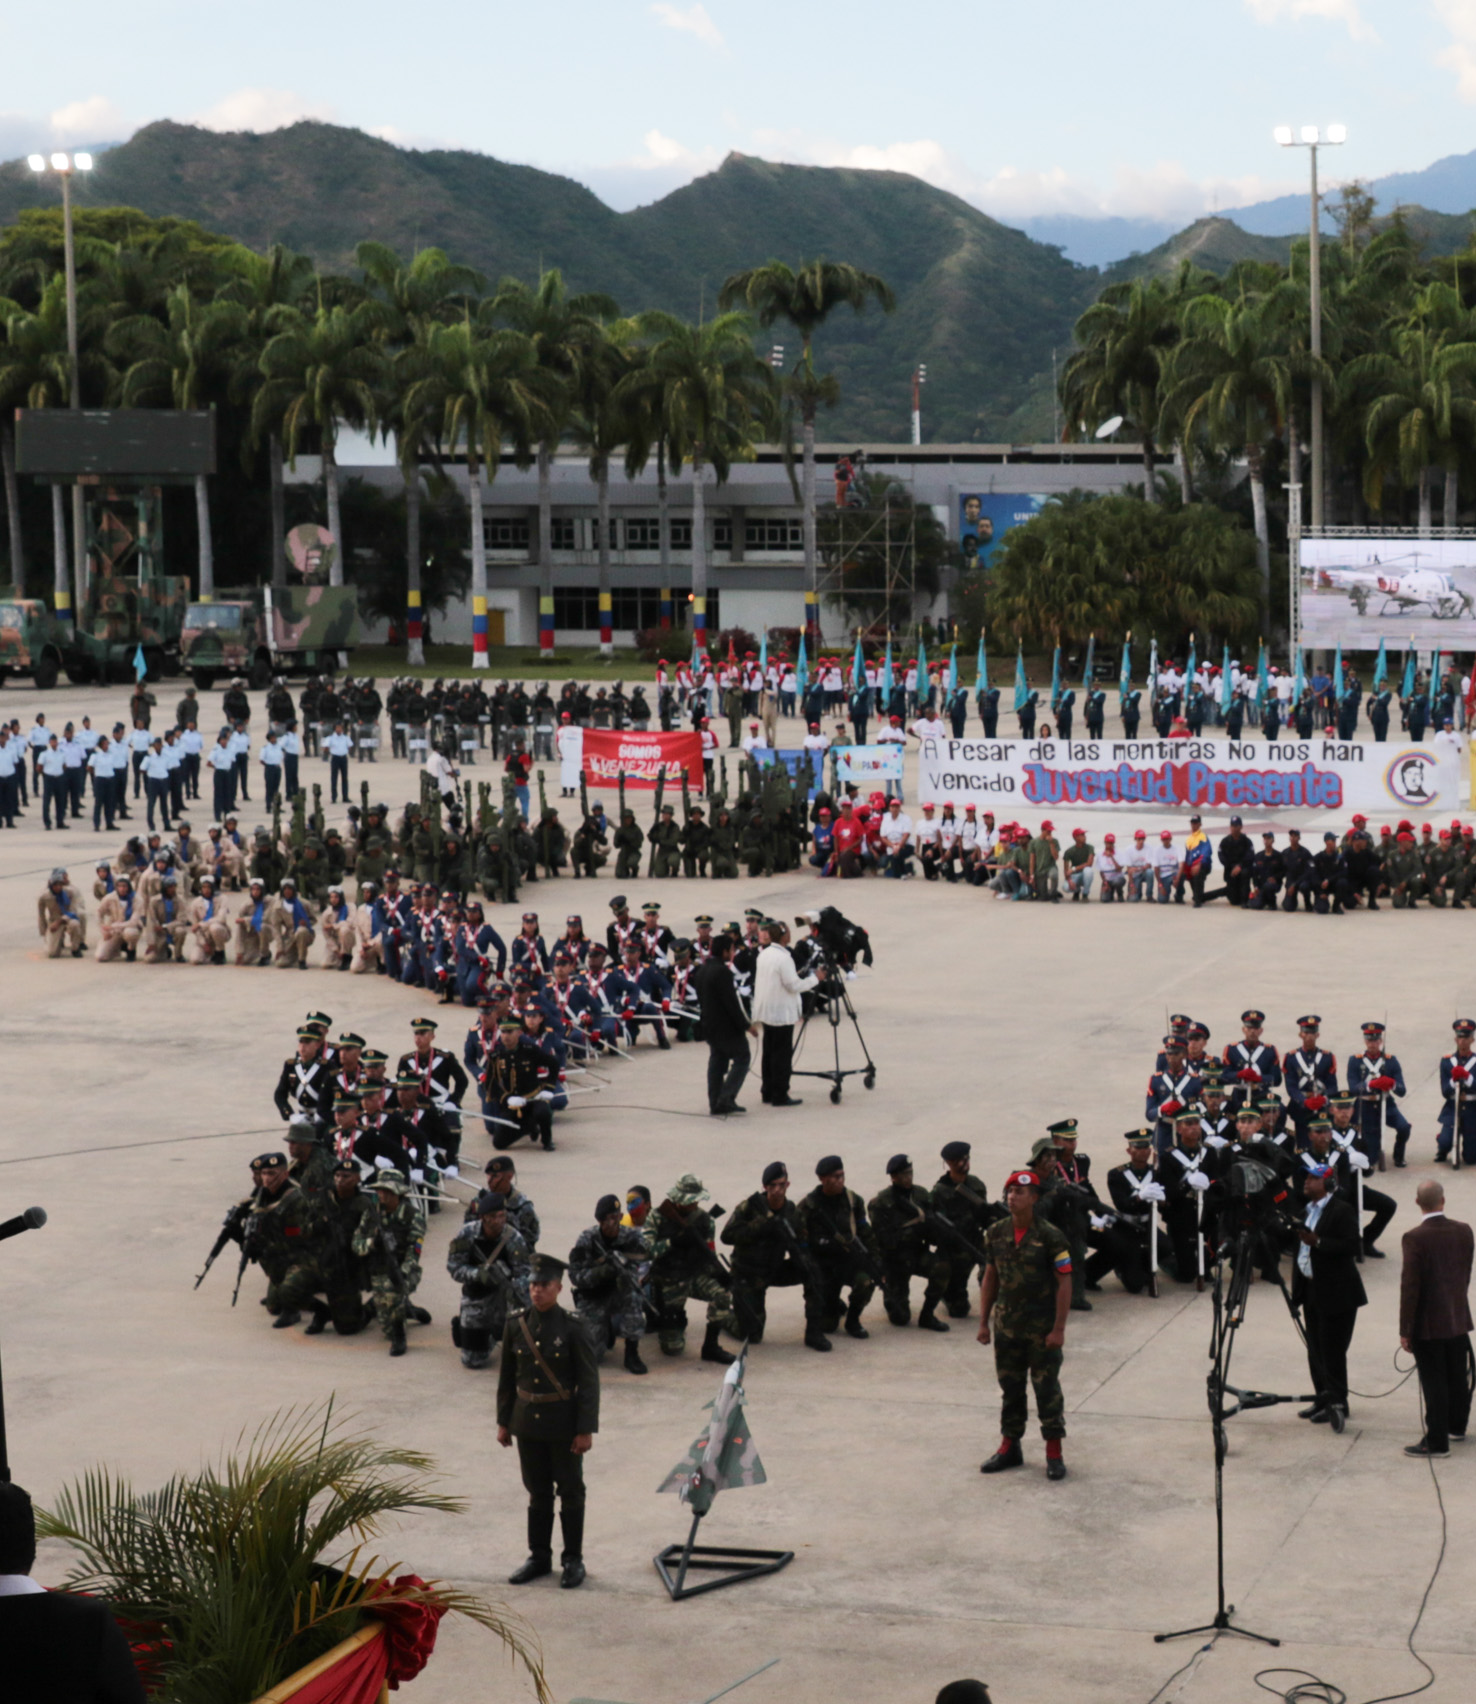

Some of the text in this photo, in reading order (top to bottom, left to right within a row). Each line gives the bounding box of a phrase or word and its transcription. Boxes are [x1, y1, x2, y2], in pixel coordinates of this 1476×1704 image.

[618, 744, 662, 759] SOMOS
[924, 738, 1364, 762] A Pesar de las mentiras No nos han
[1023, 762, 1179, 804] Juventud
[1188, 762, 1342, 806] Presente
